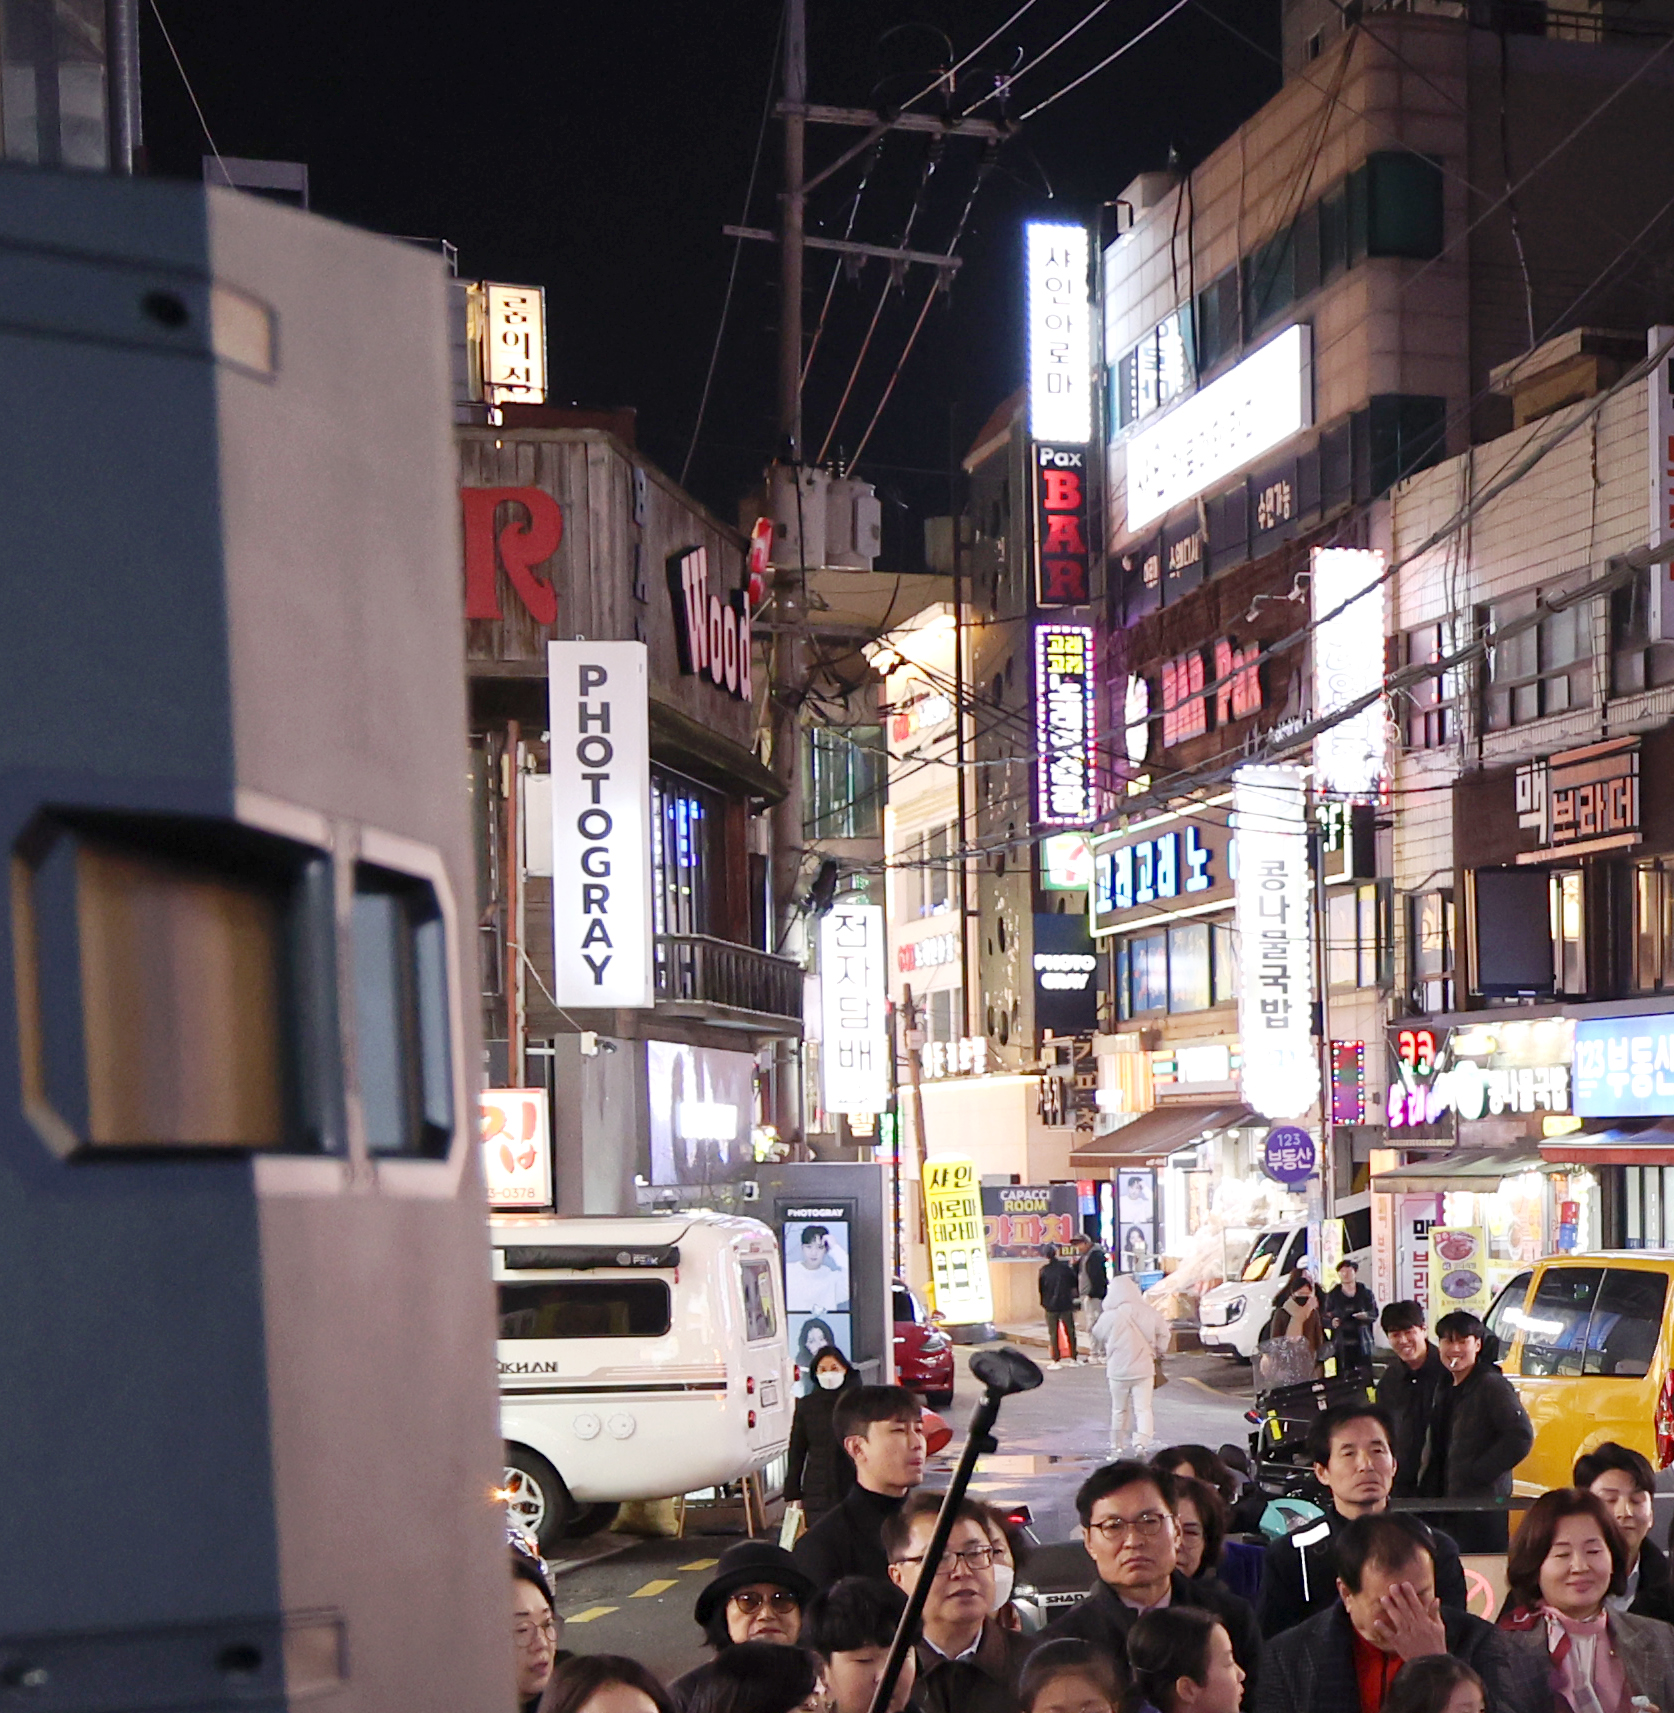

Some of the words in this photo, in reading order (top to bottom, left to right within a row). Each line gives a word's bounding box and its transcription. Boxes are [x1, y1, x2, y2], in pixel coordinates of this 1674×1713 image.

[1039, 449, 1083, 468] Pax
[1043, 470, 1086, 599] BAR
[681, 546, 752, 703] Wood
[576, 664, 614, 987] PHOTOGRAY
[1257, 859, 1294, 1029] 콩나물국밥
[1033, 953, 1097, 972] PHOTO
[834, 914, 873, 1072] 전자담배
[1277, 1133, 1301, 1147] 123
[1267, 1148, 1314, 1172] 부동산
[930, 1166, 973, 1189] 샤인
[1000, 1190, 1050, 1201] CAPACCI
[1004, 1200, 1048, 1212] ROOM
[787, 1207, 845, 1218] PHOTOGRAY
[931, 1199, 977, 1221] 아로마
